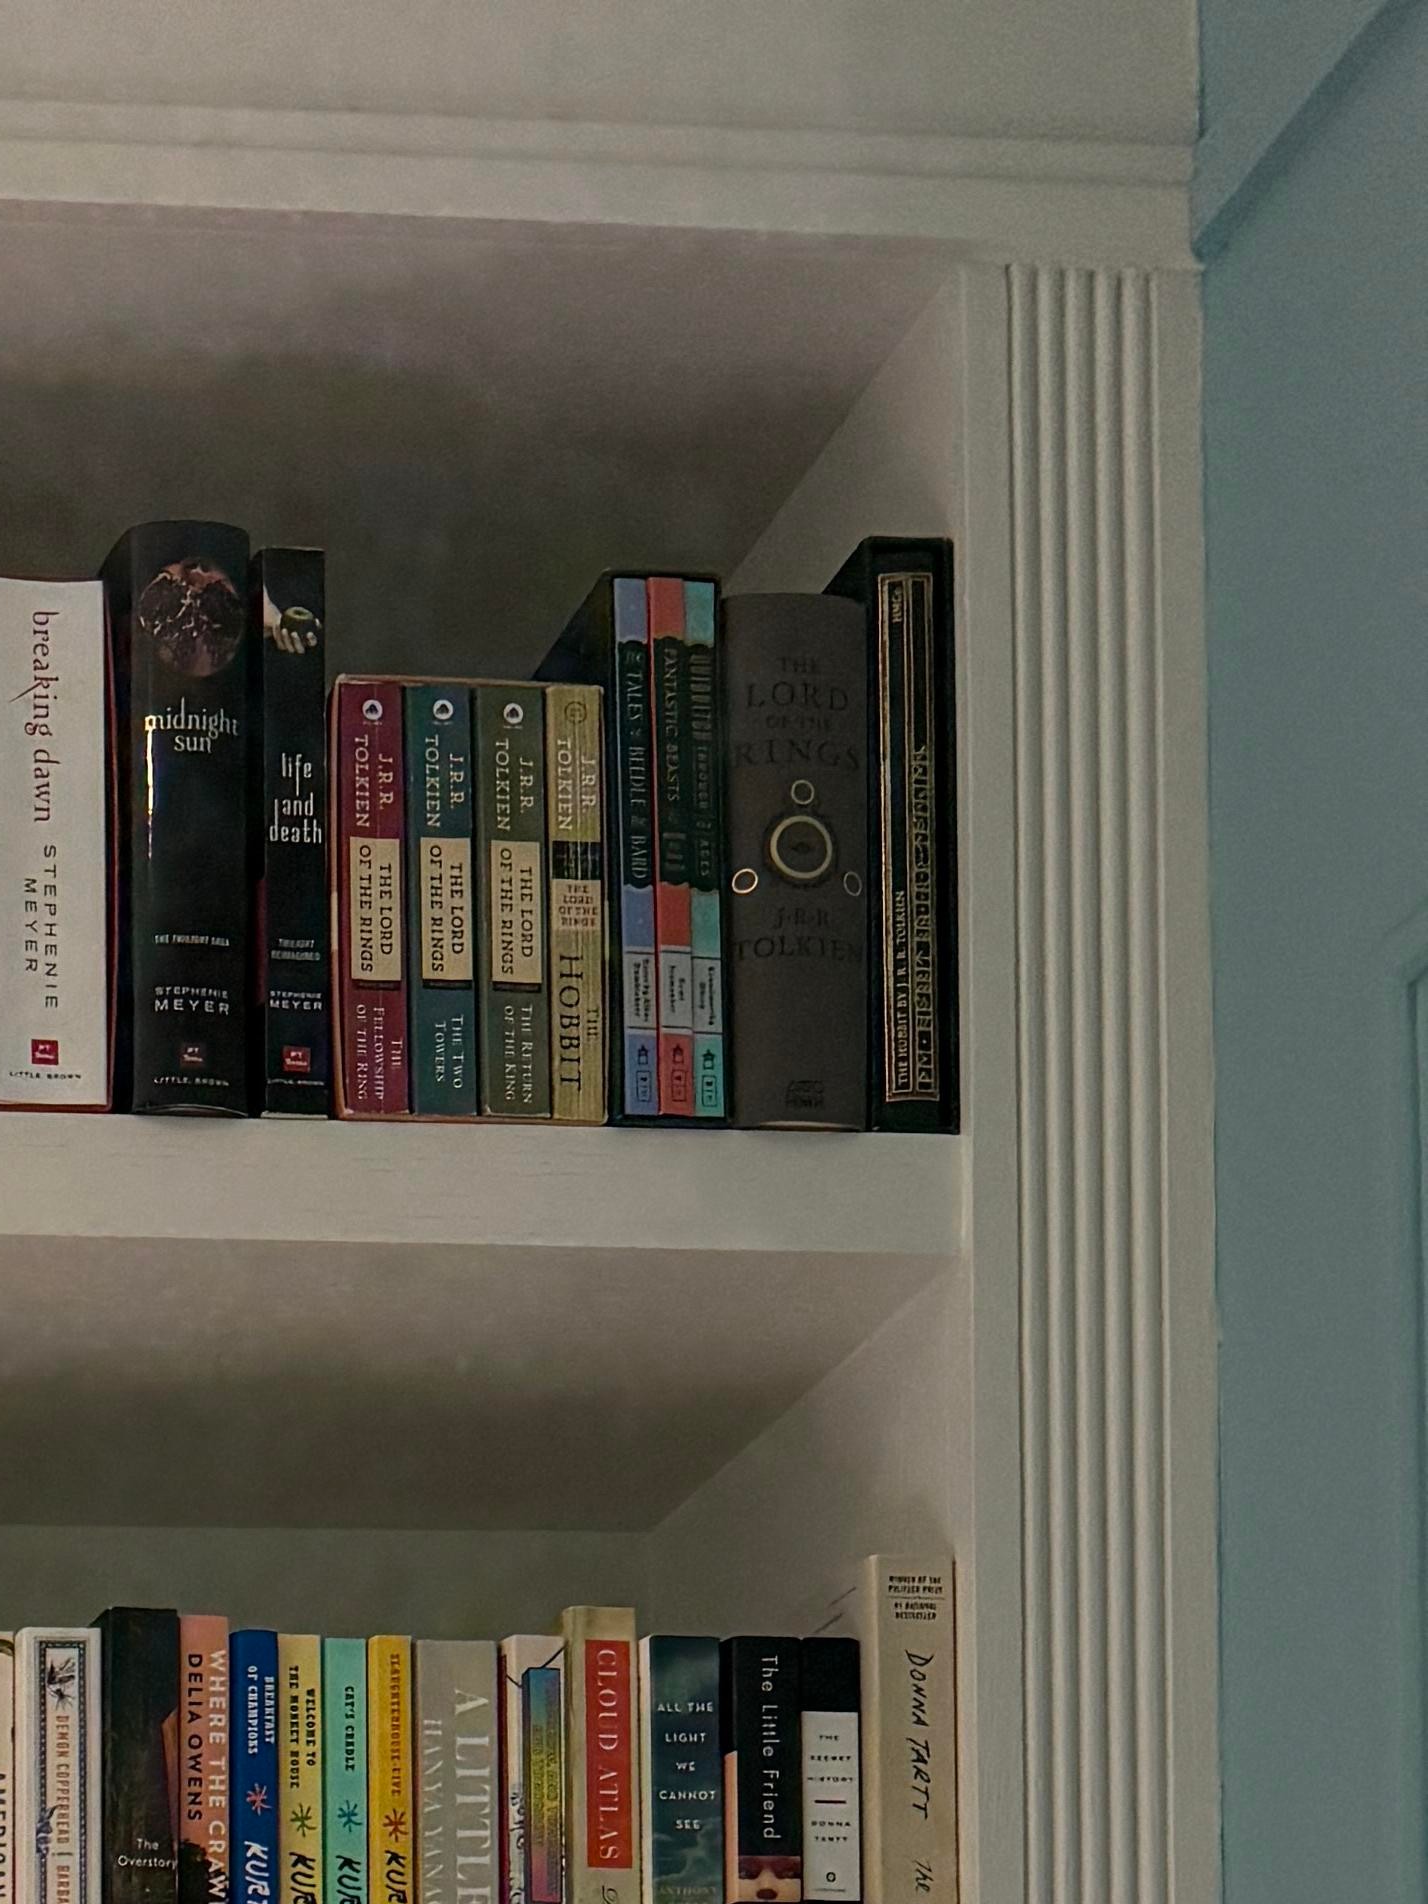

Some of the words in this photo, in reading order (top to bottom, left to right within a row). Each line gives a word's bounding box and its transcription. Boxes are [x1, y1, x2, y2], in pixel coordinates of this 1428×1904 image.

[9, 610, 59, 738] breaking
[145, 698, 239, 739] midnight
[174, 734, 211, 753] sun
[32, 748, 60, 822] dawn
[282, 753, 312, 796] life
[354, 734, 371, 828] TOLKIEN
[377, 750, 391, 812] J.R.R.
[269, 800, 322, 844] death
[282, 793, 313, 816] and
[357, 844, 372, 867] OF
[377, 862, 393, 900] THE
[358, 873, 372, 911] THE
[358, 919, 373, 973] RINGS
[378, 903, 394, 956] LORD
[557, 953, 582, 1093] HOBBIT
[209, 1650, 227, 1745] WHERE
[761, 1656, 778, 1692] The
[596, 1648, 618, 1754] CLOUD
[763, 1704, 779, 1757] Little
[209, 1756, 227, 1808] THE
[762, 1770, 779, 1839] Friend
[598, 1767, 619, 1860] ATLAS
